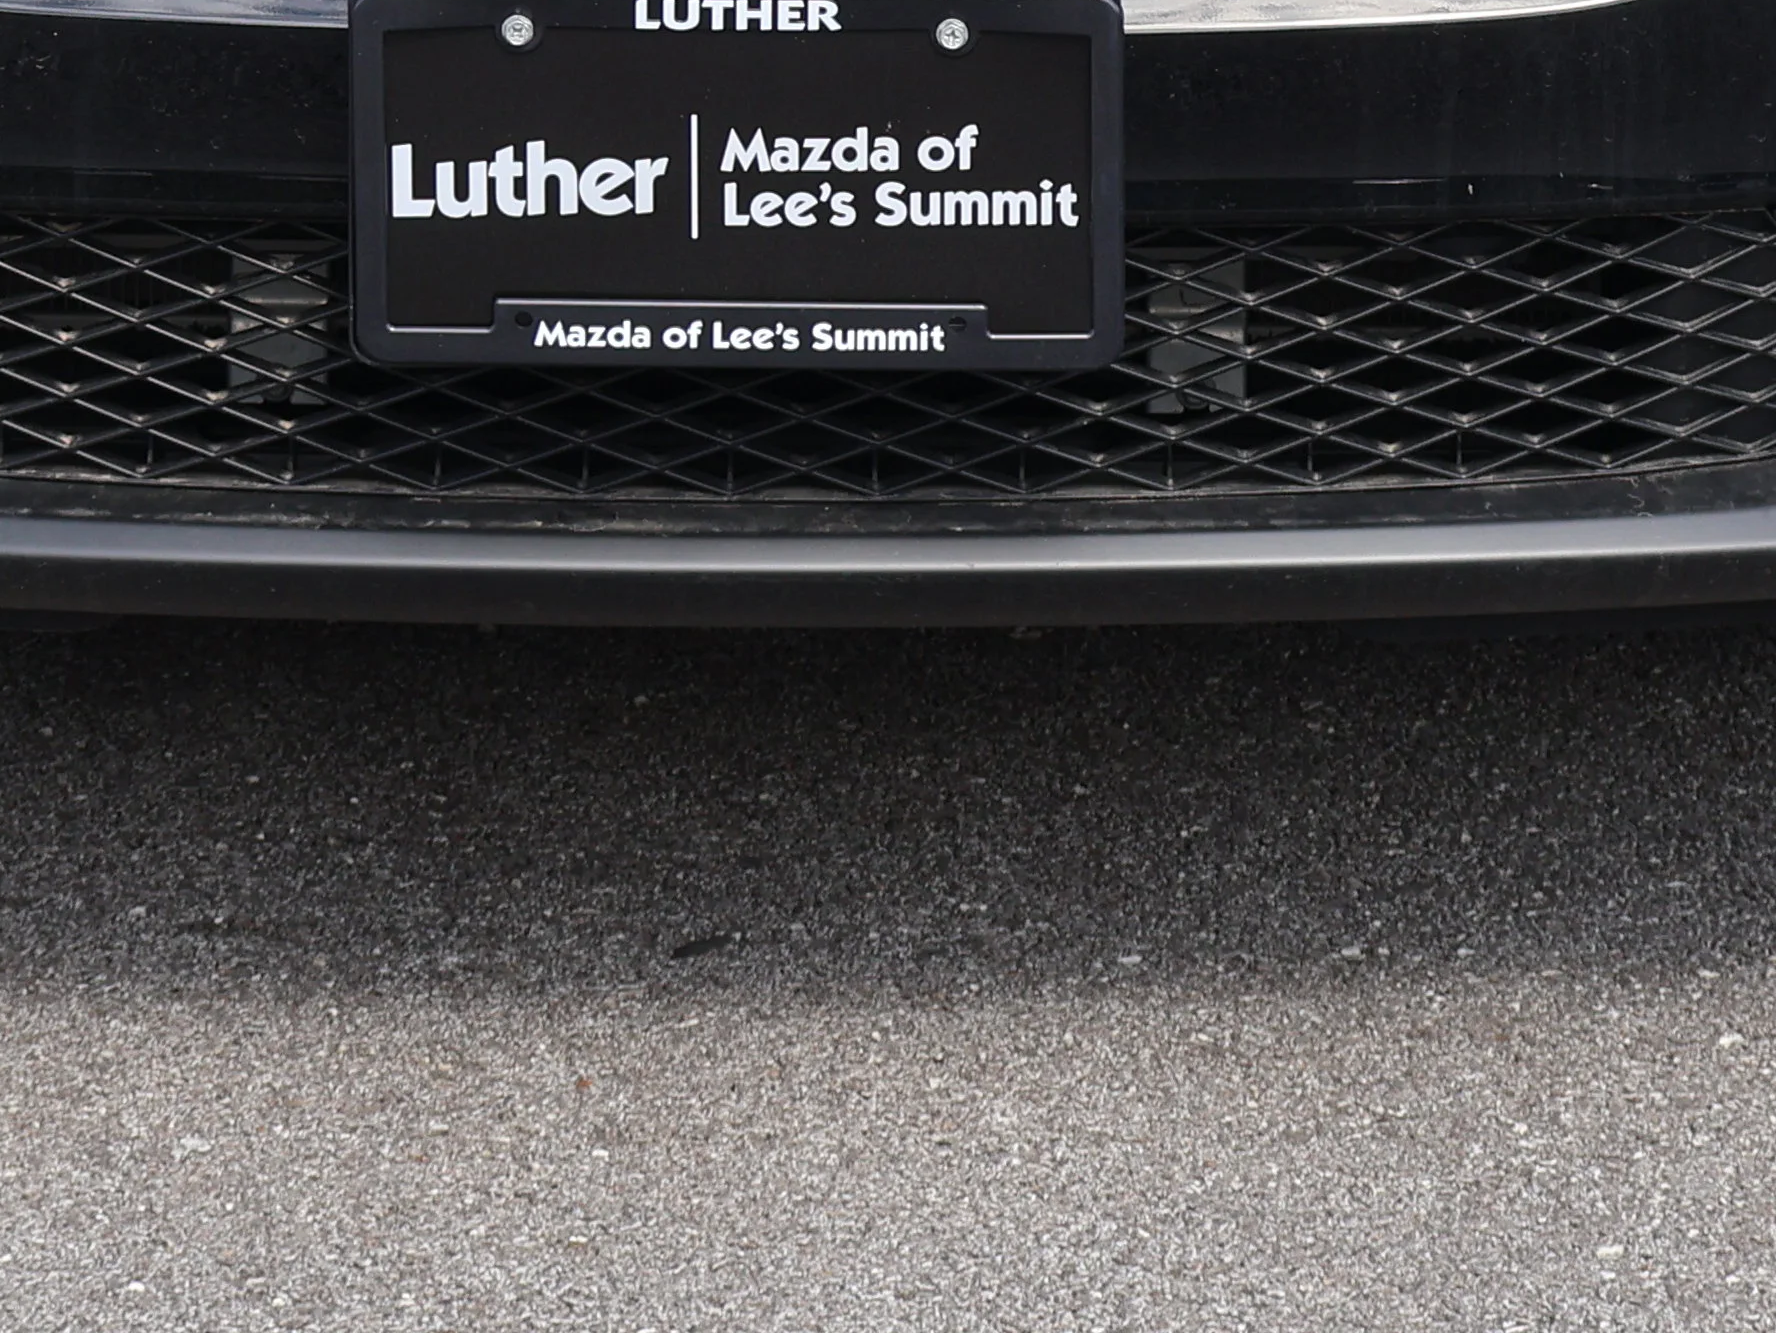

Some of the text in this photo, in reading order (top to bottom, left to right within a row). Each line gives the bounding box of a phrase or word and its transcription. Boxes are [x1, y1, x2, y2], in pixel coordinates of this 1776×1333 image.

[720, 124, 979, 173] Mazda of
[390, 140, 669, 219] Luther
[724, 179, 1079, 227] Lee's Summit
[533, 319, 945, 352] Mazda of Lee's Summit
